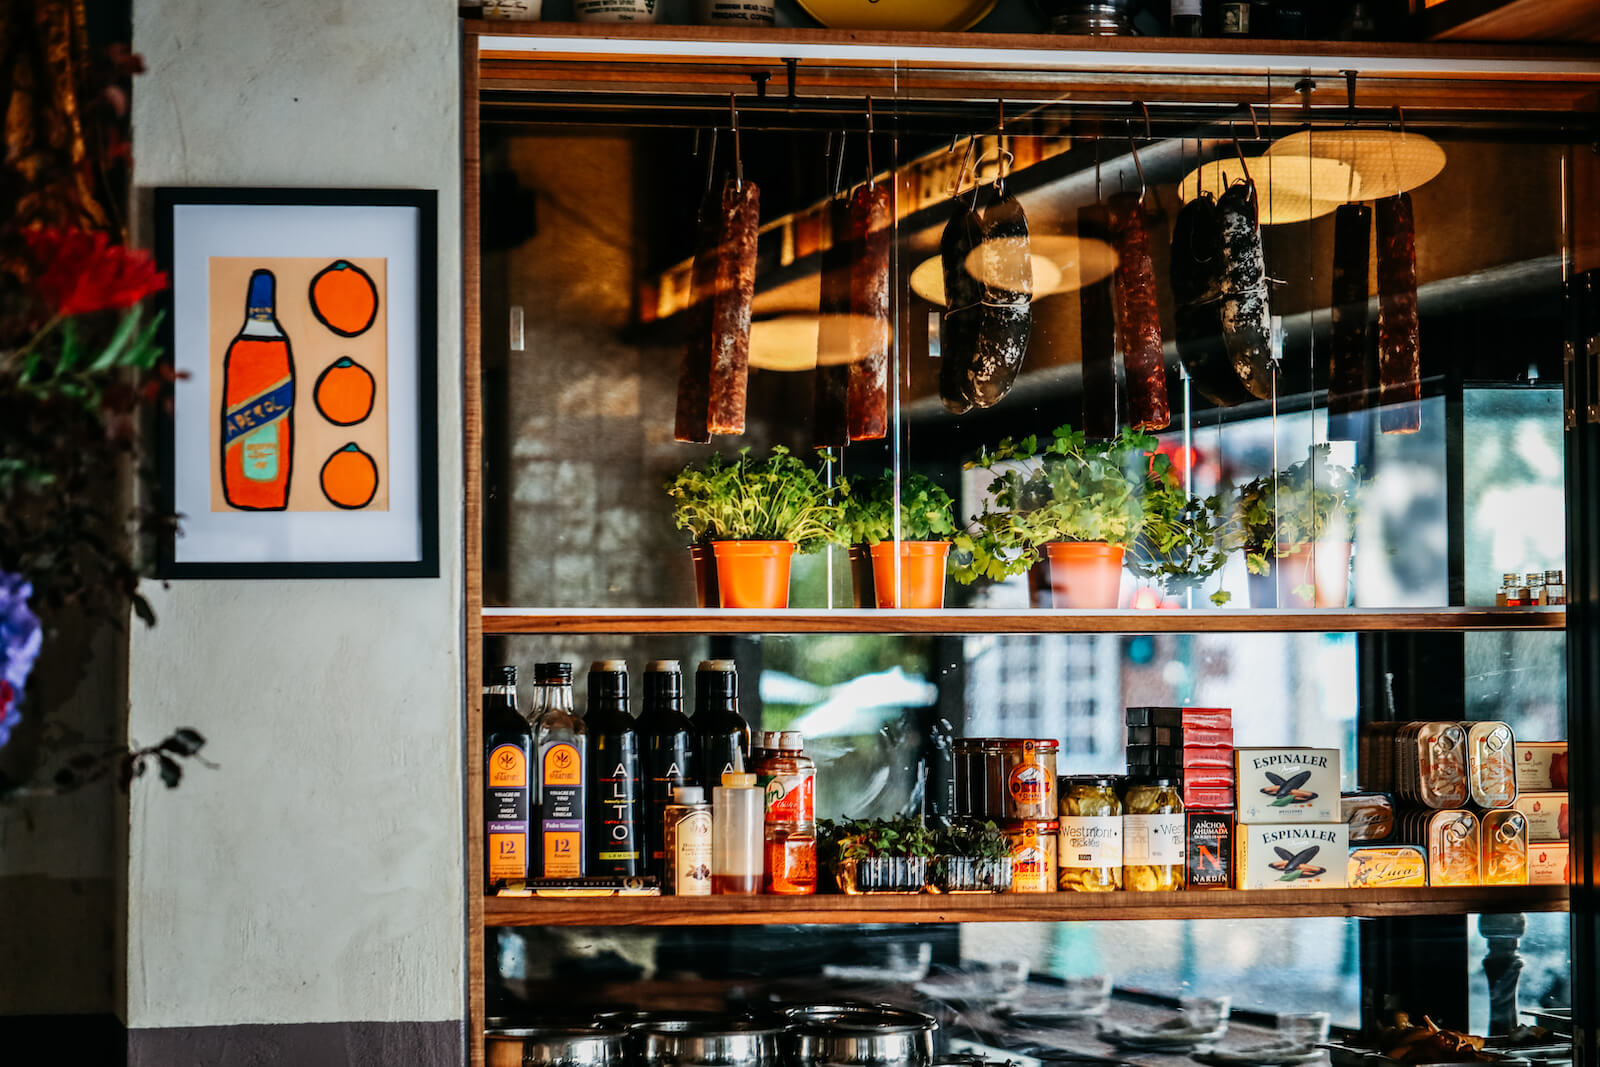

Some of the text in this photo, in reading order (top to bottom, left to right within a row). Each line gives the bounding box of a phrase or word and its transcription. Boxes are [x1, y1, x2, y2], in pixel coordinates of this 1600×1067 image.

[1253, 754, 1328, 769] ESPINALER
[1060, 825, 1113, 838] Westmont
[1262, 828, 1337, 844] ESPINALER
[500, 841, 516, 854] 12
[555, 839, 570, 853] 12
[1193, 874, 1228, 883] NARDÍN
